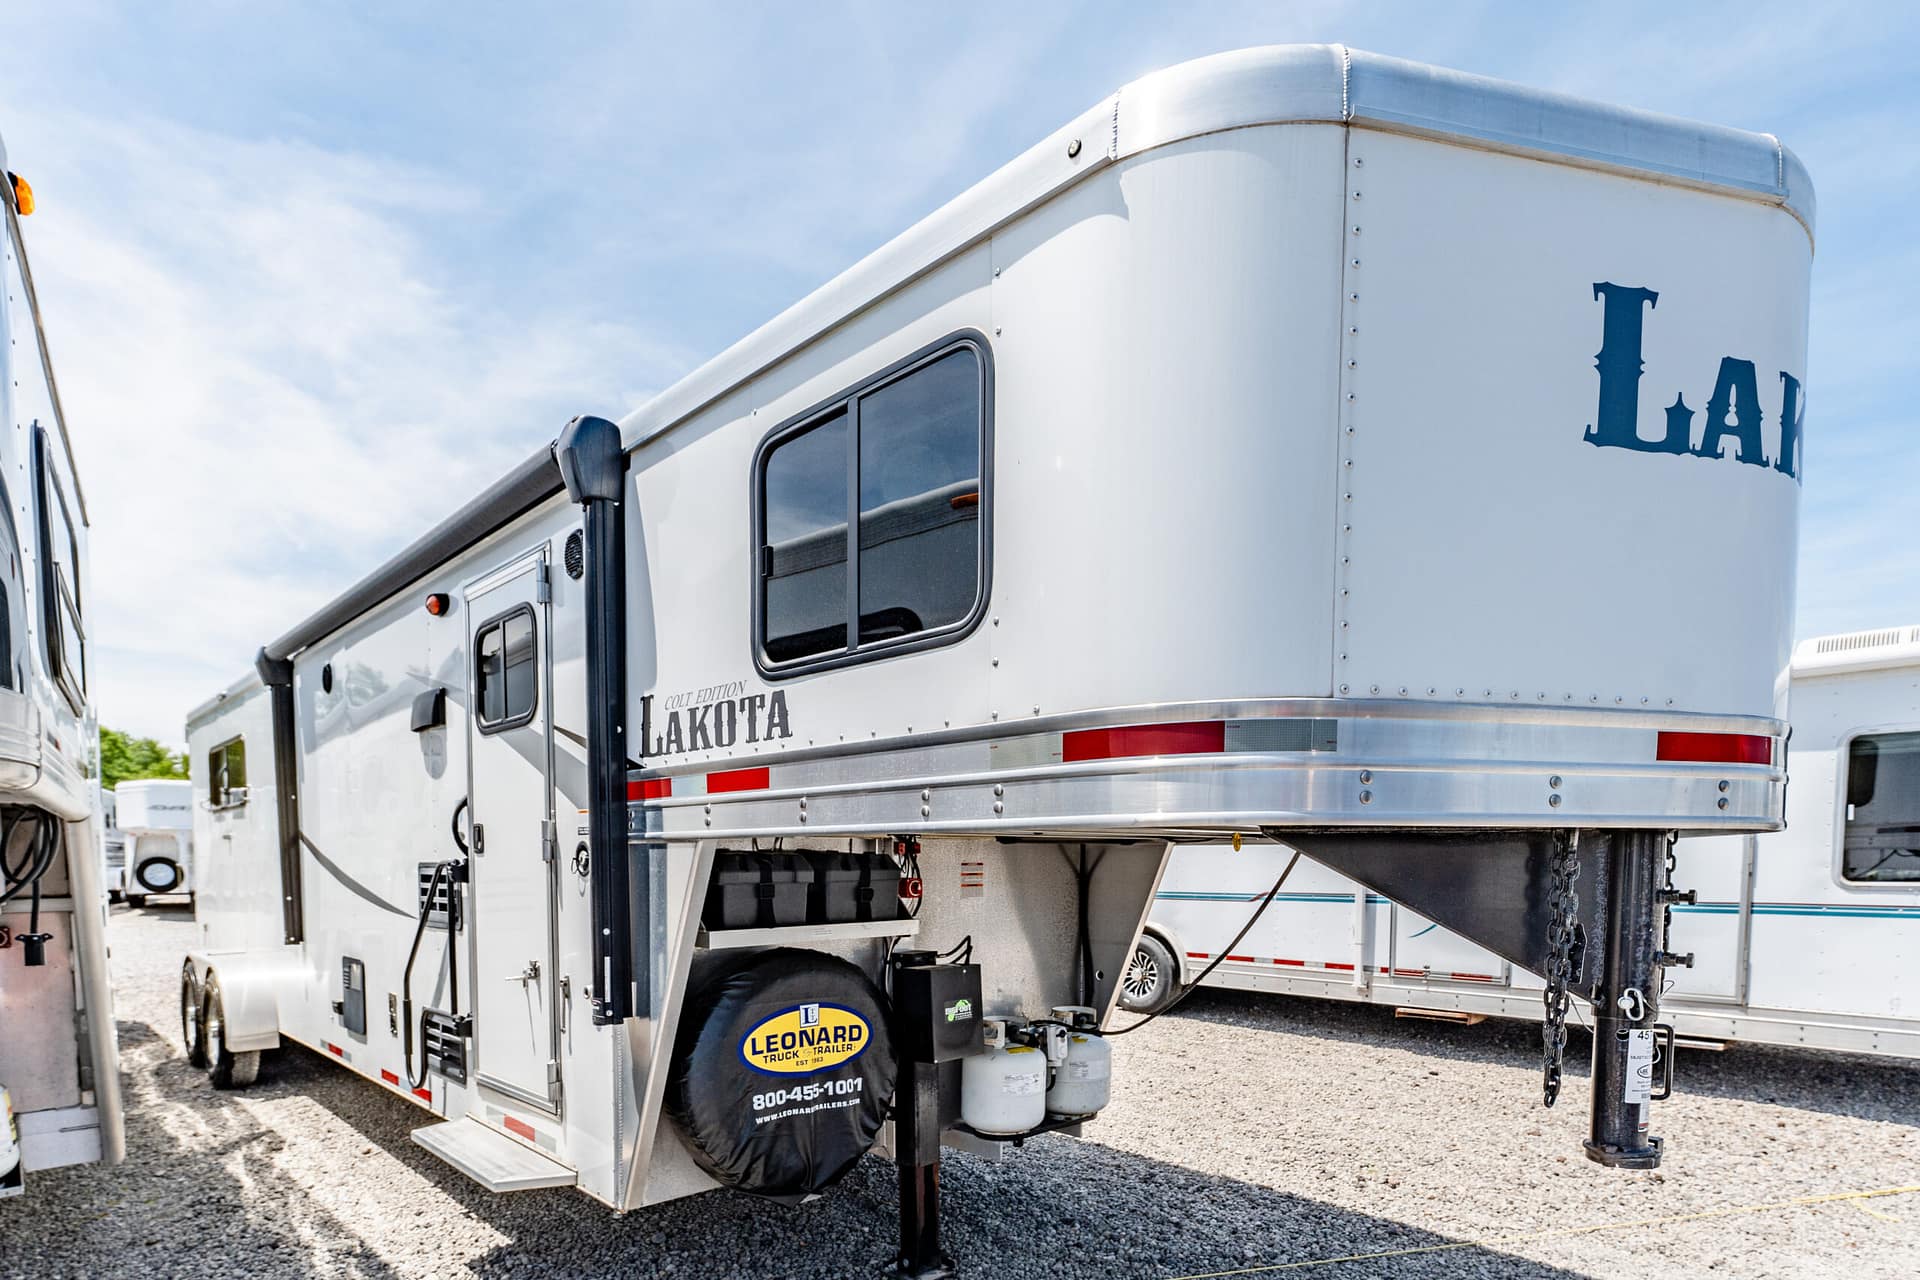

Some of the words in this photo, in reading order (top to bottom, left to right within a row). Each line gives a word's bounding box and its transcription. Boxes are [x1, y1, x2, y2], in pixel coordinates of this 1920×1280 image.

[665, 692, 694, 711] COLT
[695, 680, 747, 704] EDITION
[639, 689, 793, 758] LAKOTA
[751, 1024, 862, 1055] LEONARD
[763, 1050, 799, 1064] TRUCK
[813, 1044, 853, 1056] TRAILER
[752, 1077, 863, 1111] 800-455-1001
